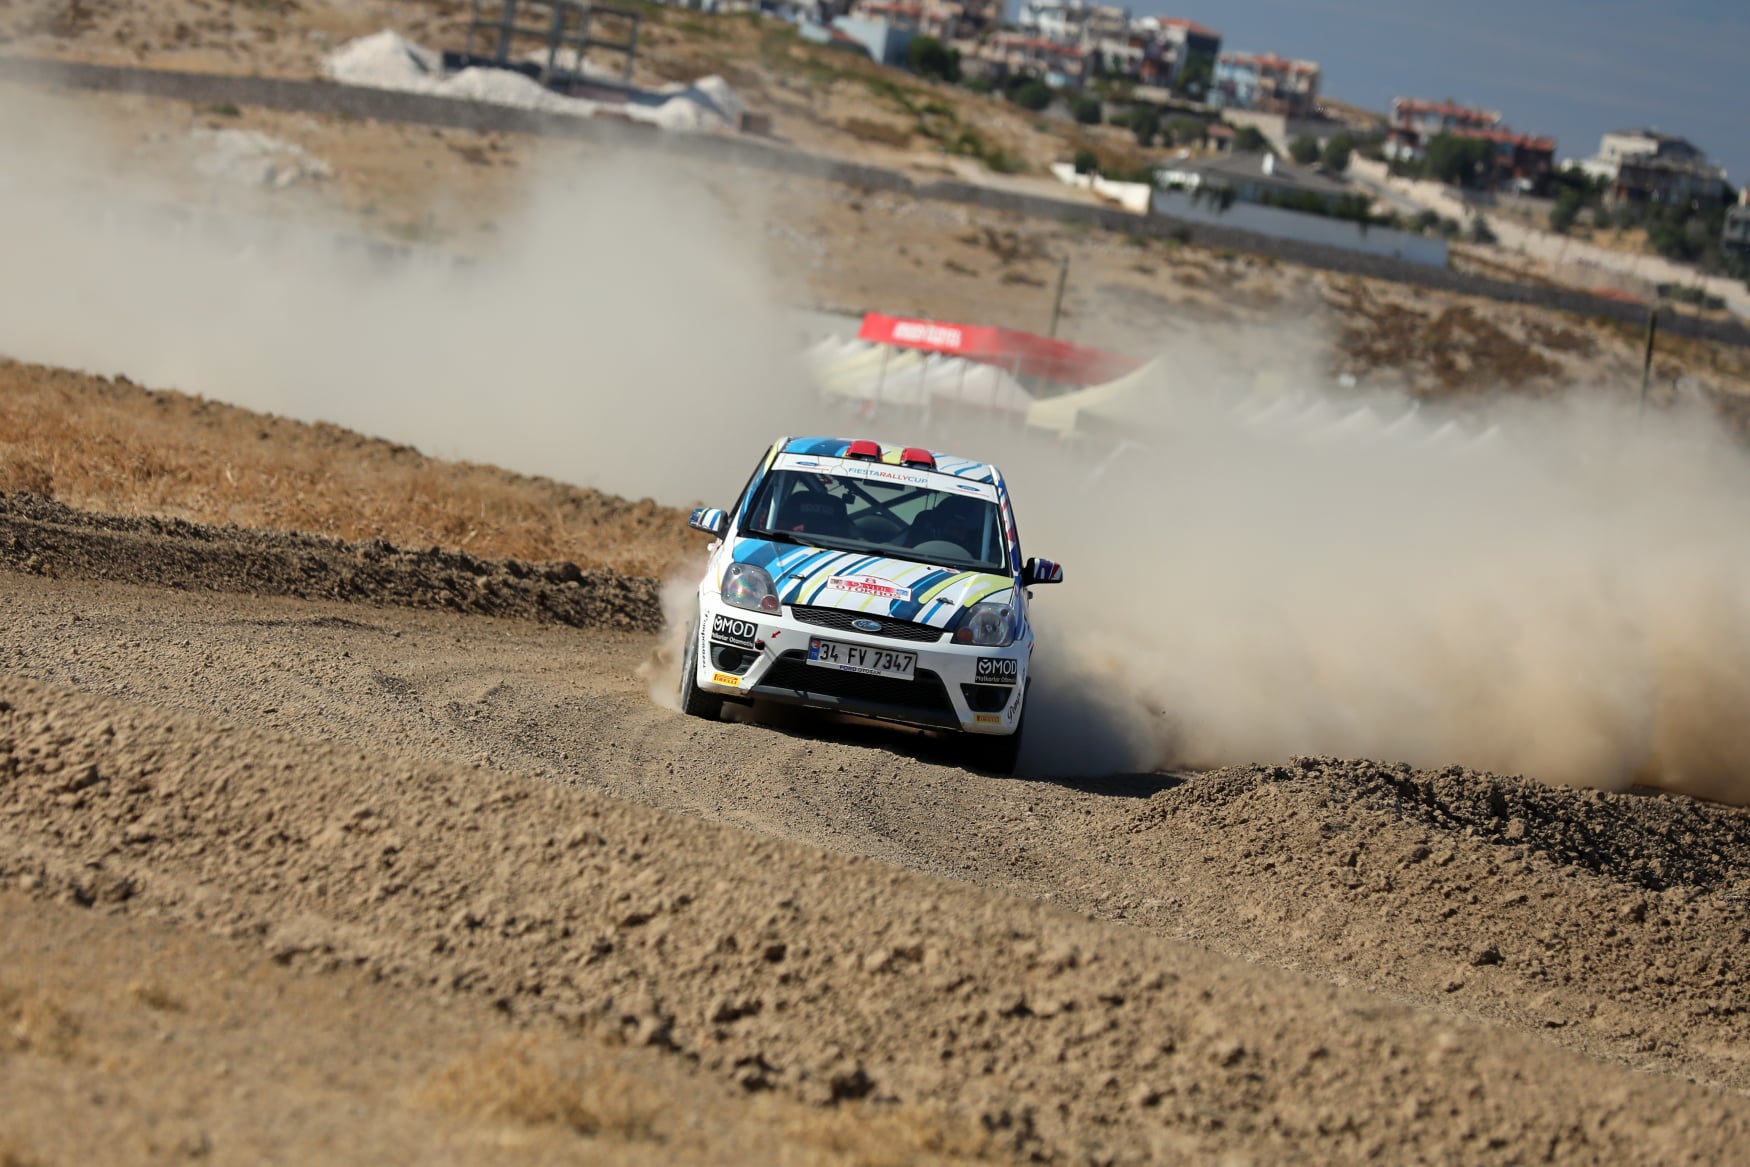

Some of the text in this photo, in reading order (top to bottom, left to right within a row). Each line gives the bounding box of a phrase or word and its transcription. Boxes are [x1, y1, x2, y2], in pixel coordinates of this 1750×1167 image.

[721, 617, 755, 638] MOD
[820, 643, 838, 662] 34
[847, 647, 867, 666] FV
[873, 651, 912, 672] 7347
[992, 659, 1017, 675] MOD
[714, 673, 738, 685] PIRELLI
